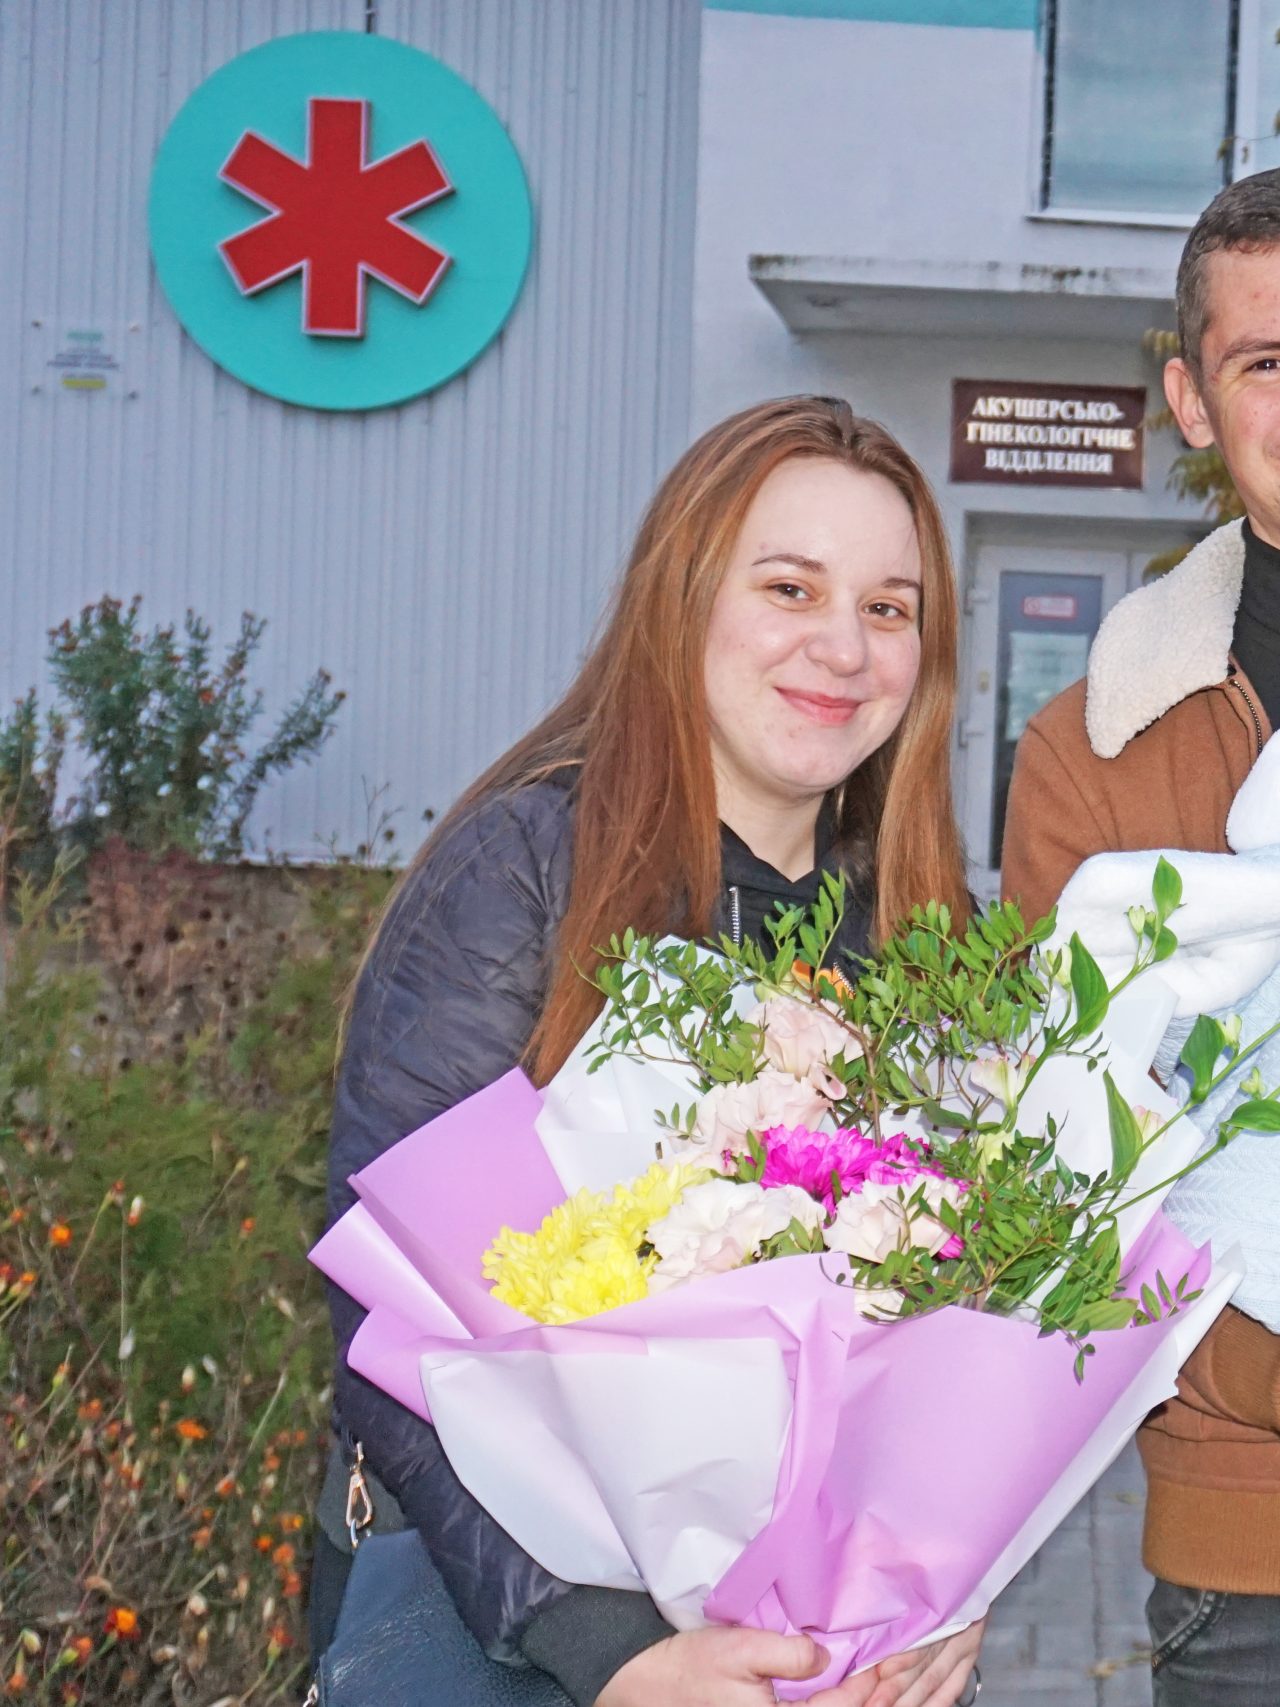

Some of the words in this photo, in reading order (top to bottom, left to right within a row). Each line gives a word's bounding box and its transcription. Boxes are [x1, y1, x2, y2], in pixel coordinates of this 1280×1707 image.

[972, 397, 1124, 422] АКУШЕРСЬКО-
[966, 422, 1135, 450] ГІНЕКОЛОГІЧНЕ
[985, 449, 1113, 474] ВІДДІЛЕННЯ
